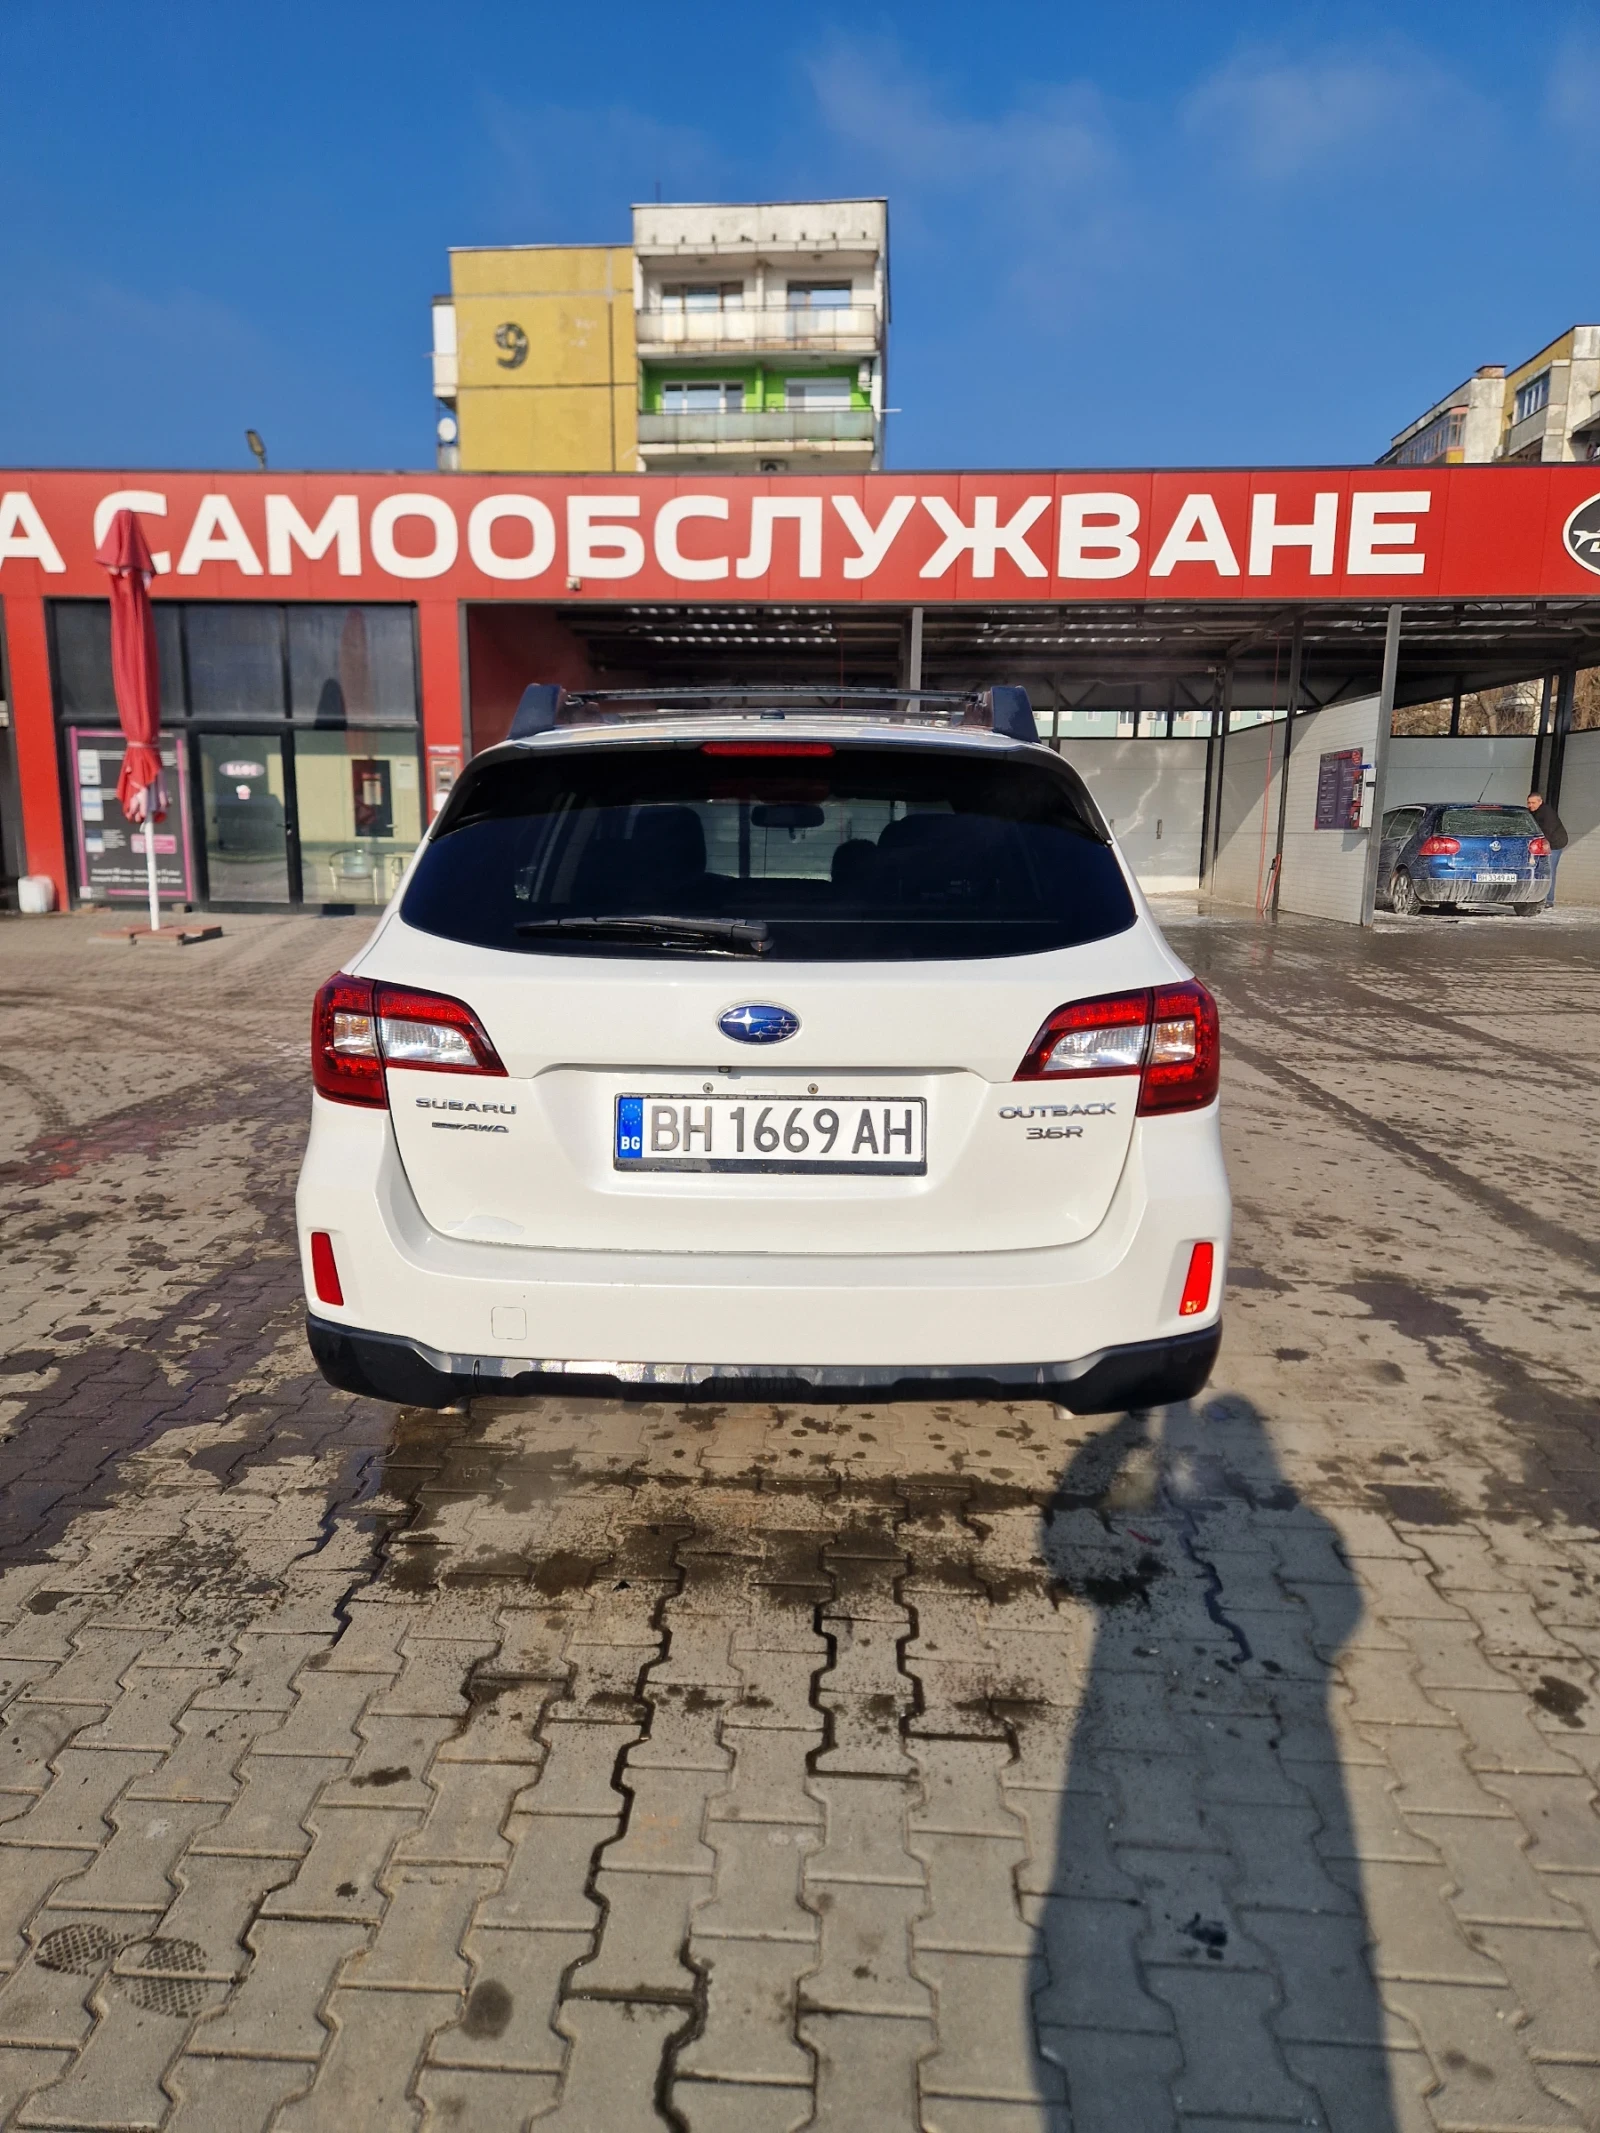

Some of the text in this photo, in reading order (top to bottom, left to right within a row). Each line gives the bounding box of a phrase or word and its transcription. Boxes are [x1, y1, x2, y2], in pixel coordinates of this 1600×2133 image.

[494, 322, 530, 370] 9
[93, 489, 1432, 581] САМООБСЛУЖВАНЕ
[415, 1097, 517, 1115] SUBARU
[998, 1102, 1117, 1119] OUTBACK
[462, 1123, 509, 1133] AWD
[651, 1105, 912, 1154] BH 1669 AH
[621, 1136, 641, 1150] BG
